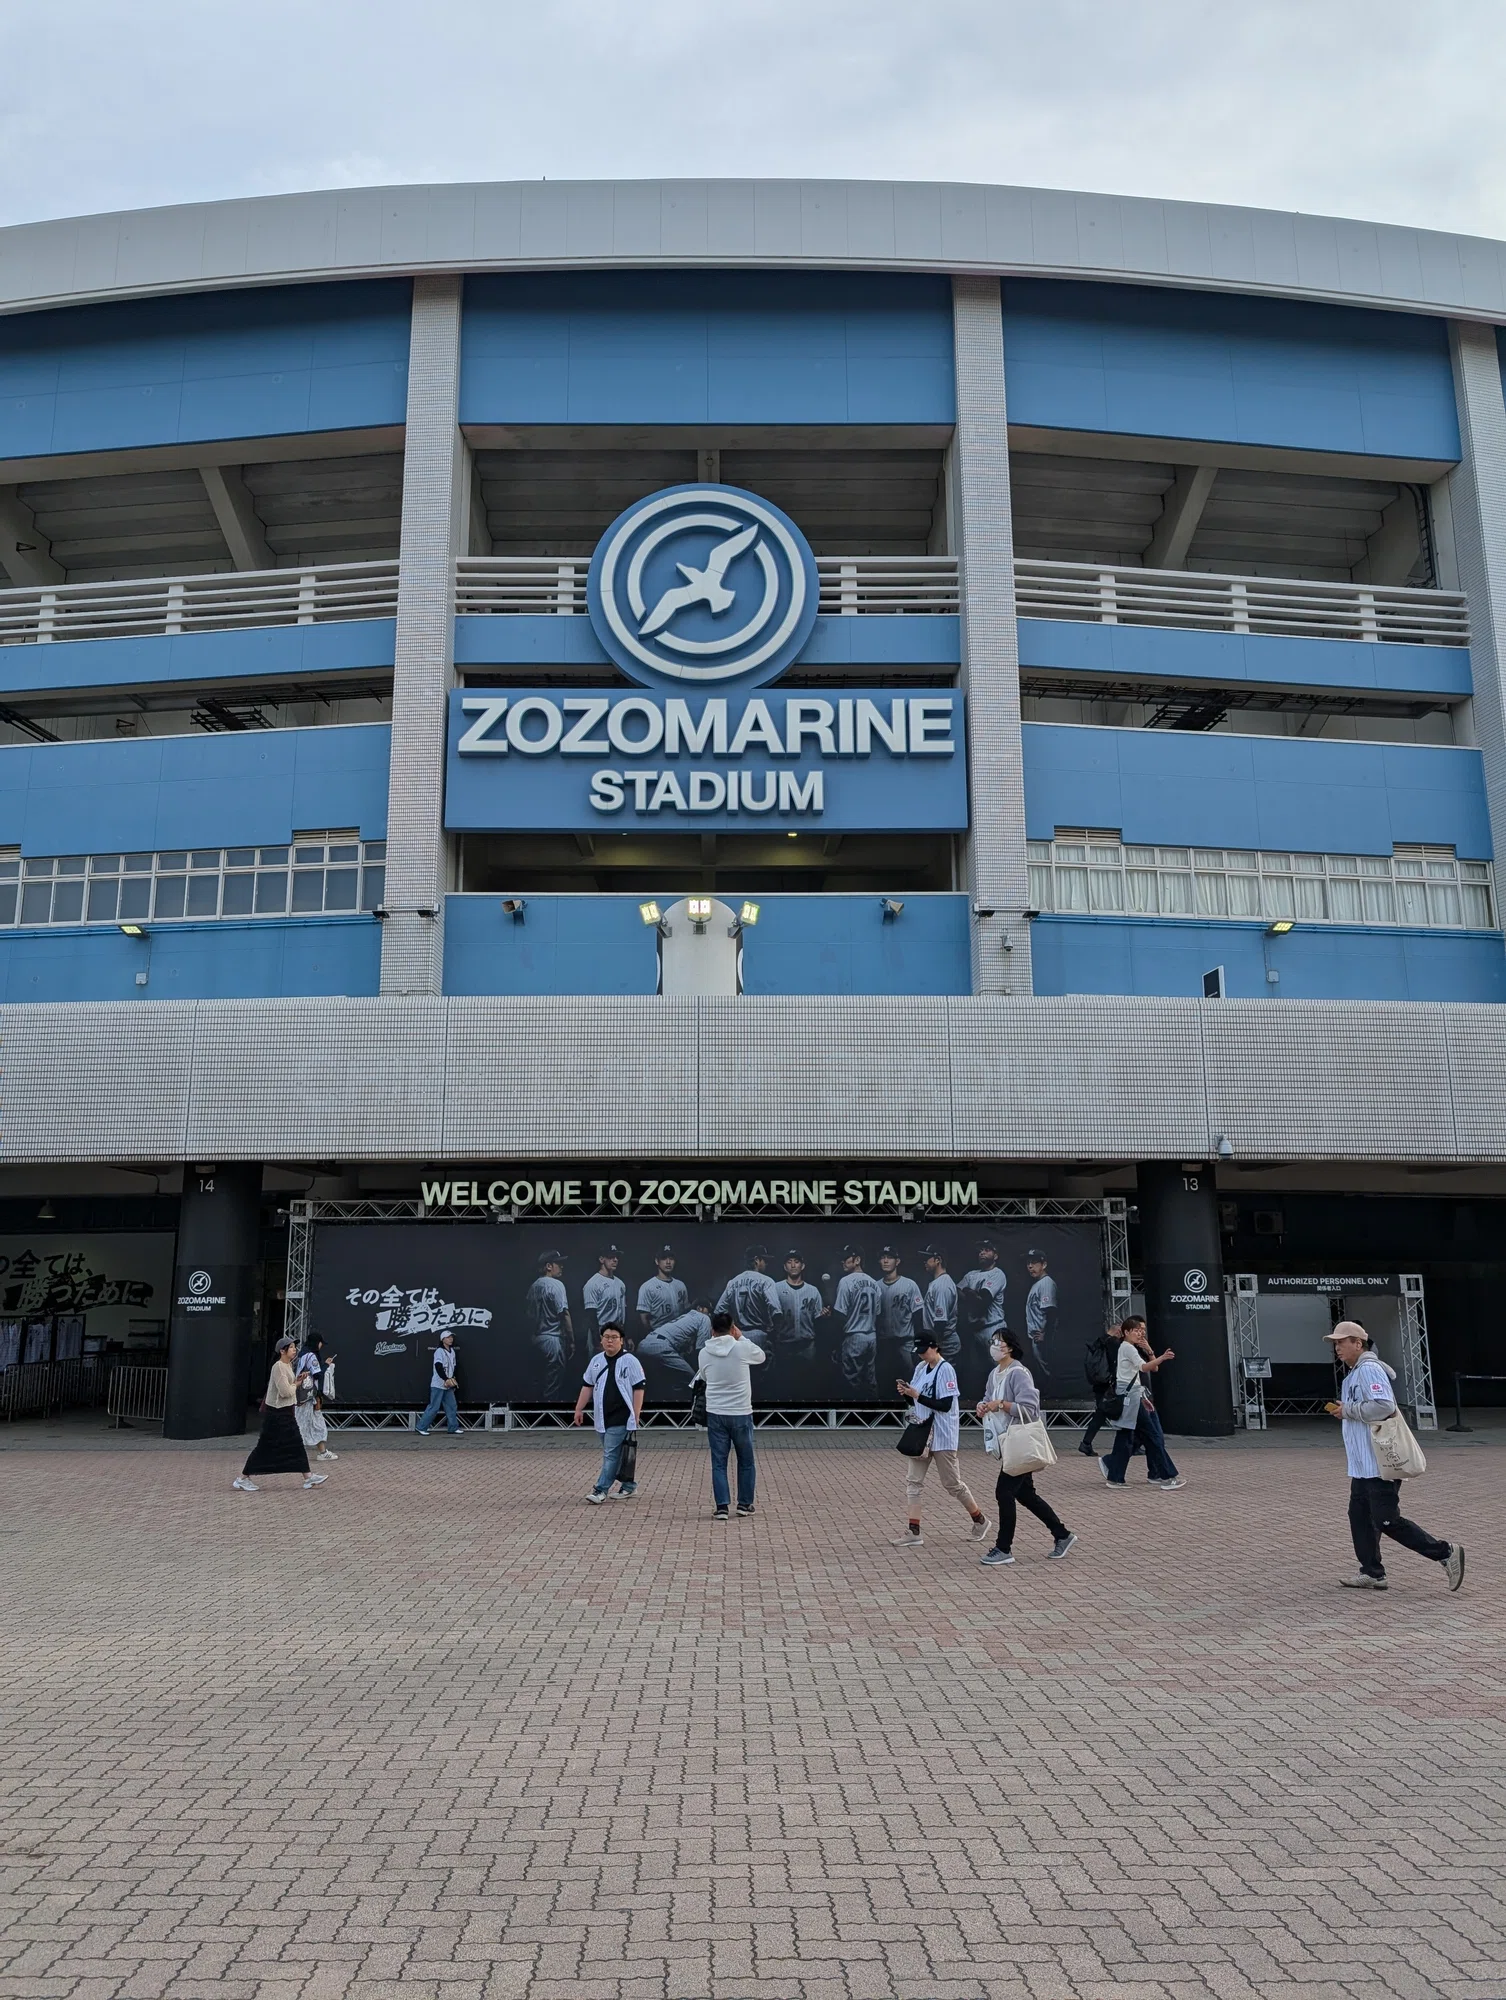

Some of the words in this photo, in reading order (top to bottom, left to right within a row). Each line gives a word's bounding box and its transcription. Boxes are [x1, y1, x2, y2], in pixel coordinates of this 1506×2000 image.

[457, 697, 956, 758] ZOZOMARINE
[589, 770, 825, 815] STADIUM
[199, 1179, 215, 1193] 14
[421, 1180, 582, 1206] WELCOME
[590, 1180, 632, 1205] TO
[638, 1180, 837, 1205] ZOZOMARINE
[843, 1180, 979, 1206] STADIUM
[1182, 1177, 1199, 1191] 13
[1267, 1277, 1319, 1285] AUTHORIZED
[1320, 1277, 1367, 1285] PERSONNEL
[1367, 1277, 1389, 1285] ONLY
[177, 1296, 226, 1305] ZOZOMARINE
[345, 1284, 446, 1307] その全ては、
[859, 1292, 875, 1316] 21
[1170, 1295, 1220, 1303] ZOZOMARINE
[387, 1306, 491, 1329] 勝つために。
[660, 1304, 672, 1315] 16
